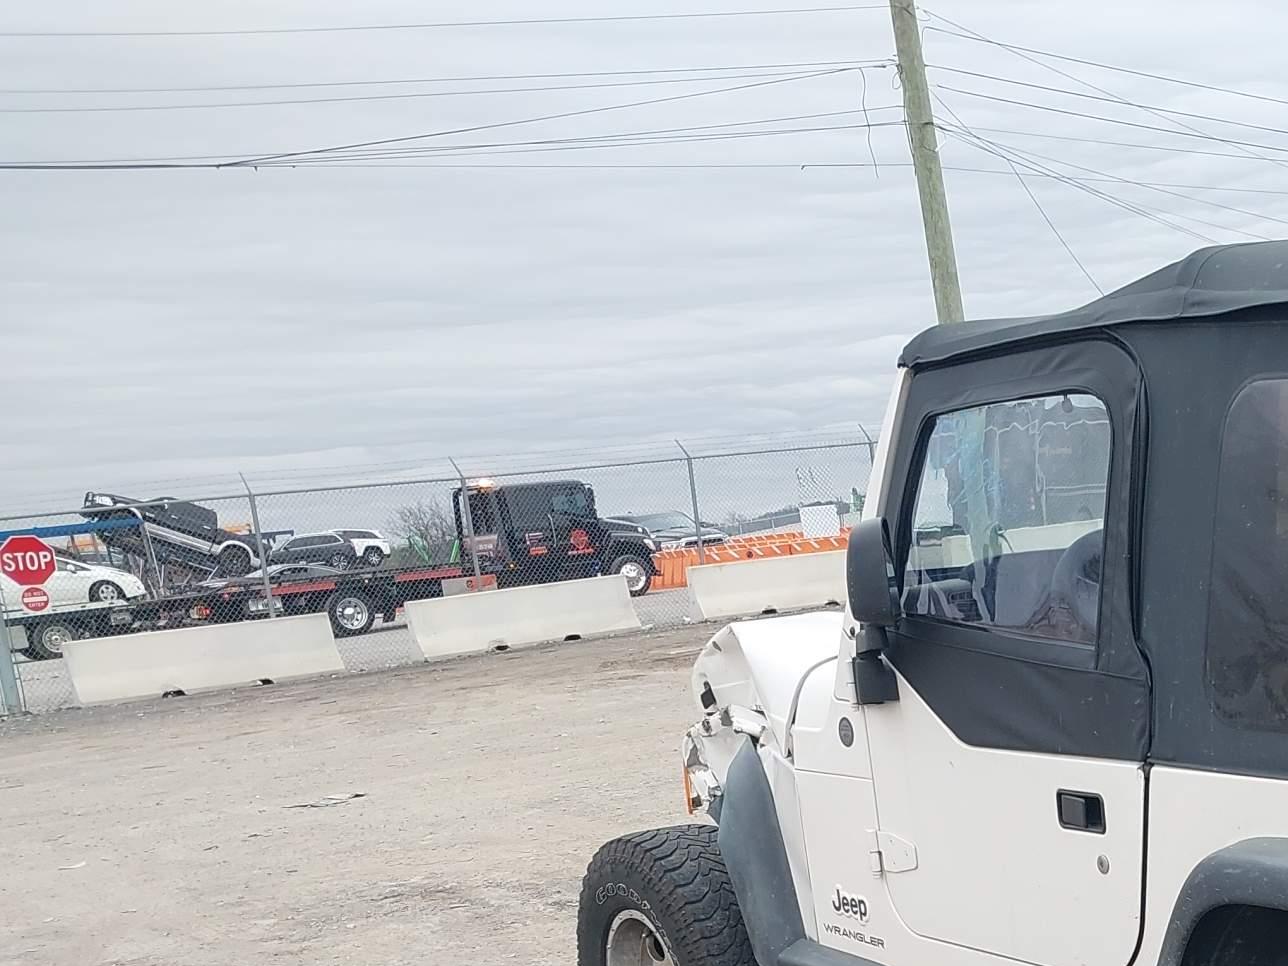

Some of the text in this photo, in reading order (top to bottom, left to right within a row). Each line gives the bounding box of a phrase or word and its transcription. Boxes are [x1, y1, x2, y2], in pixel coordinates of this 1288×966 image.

[2, 551, 52, 572] STOP
[832, 888, 868, 921] Jeep
[823, 922, 885, 949] WRANGLER
